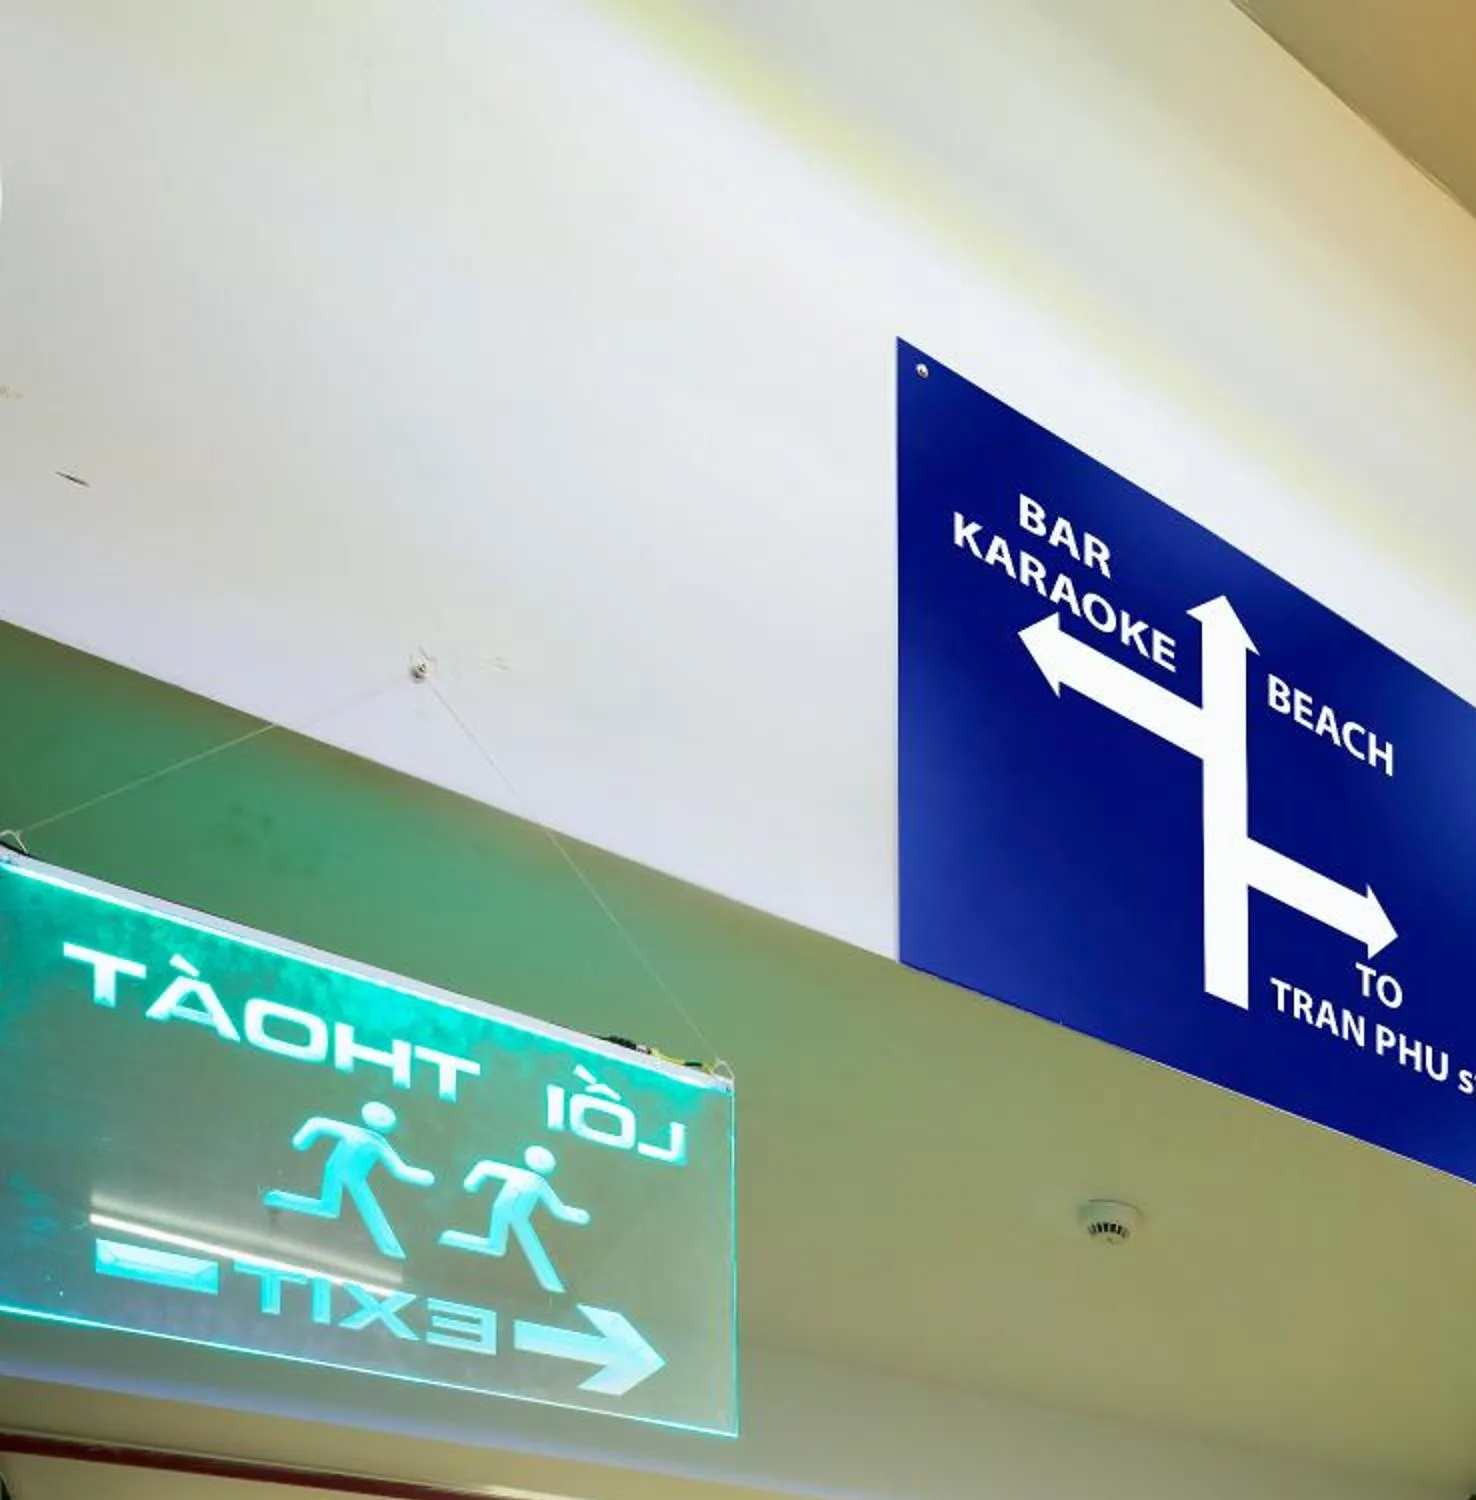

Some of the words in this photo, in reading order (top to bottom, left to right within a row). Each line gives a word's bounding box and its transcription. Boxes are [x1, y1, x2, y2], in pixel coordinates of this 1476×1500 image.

[1019, 493, 1111, 579] BAR
[953, 511, 1177, 673] KARAOKE
[1268, 673, 1394, 777] BEACH
[1270, 977, 1366, 1048] TRAN
[1375, 1023, 1449, 1082] PHU
[1355, 962, 1404, 1009] TO
